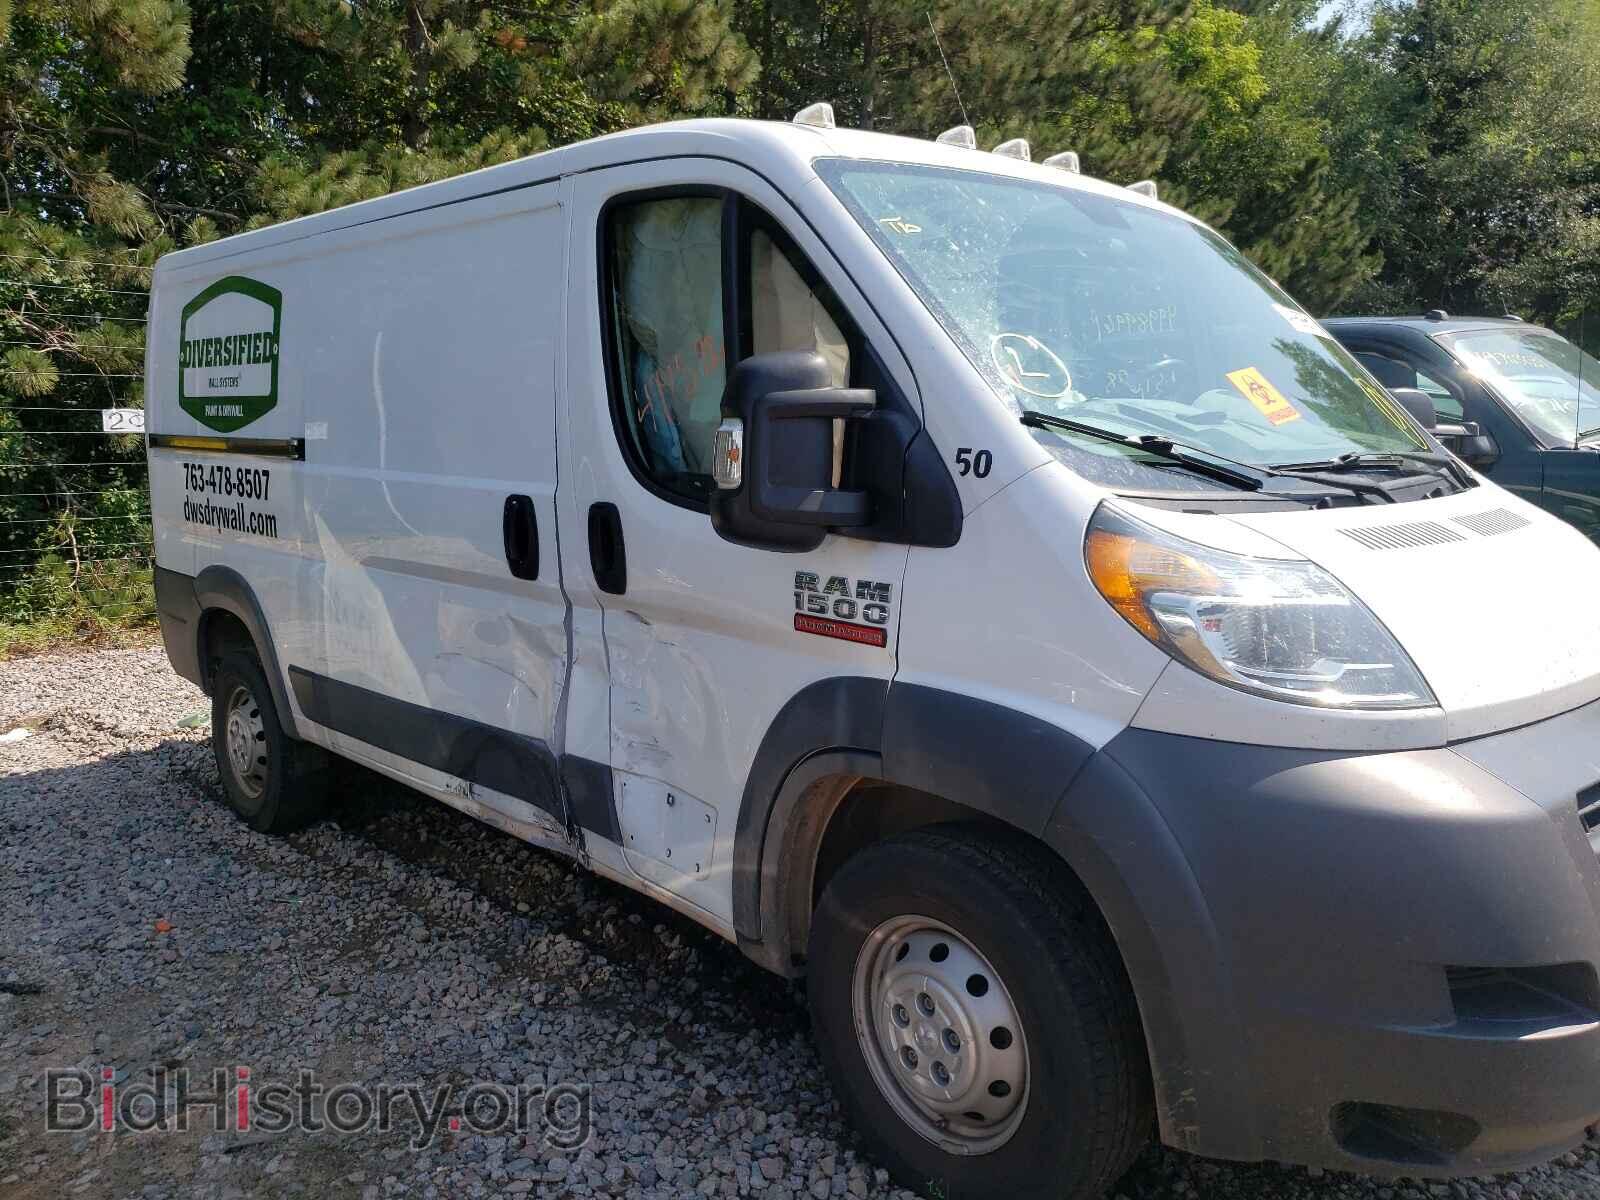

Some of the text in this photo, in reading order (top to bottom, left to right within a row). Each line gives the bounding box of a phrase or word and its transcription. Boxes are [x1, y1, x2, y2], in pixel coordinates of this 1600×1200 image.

[184, 332, 272, 368] DIVERSIFIED
[205, 405, 217, 417] PAINT
[223, 405, 243, 416] DRYWALL
[956, 447, 993, 478] 50
[183, 462, 270, 501] 763-478-8507
[183, 494, 278, 538] dwsdrywall.com
[794, 570, 892, 604] RAM
[793, 590, 890, 625] 1500
